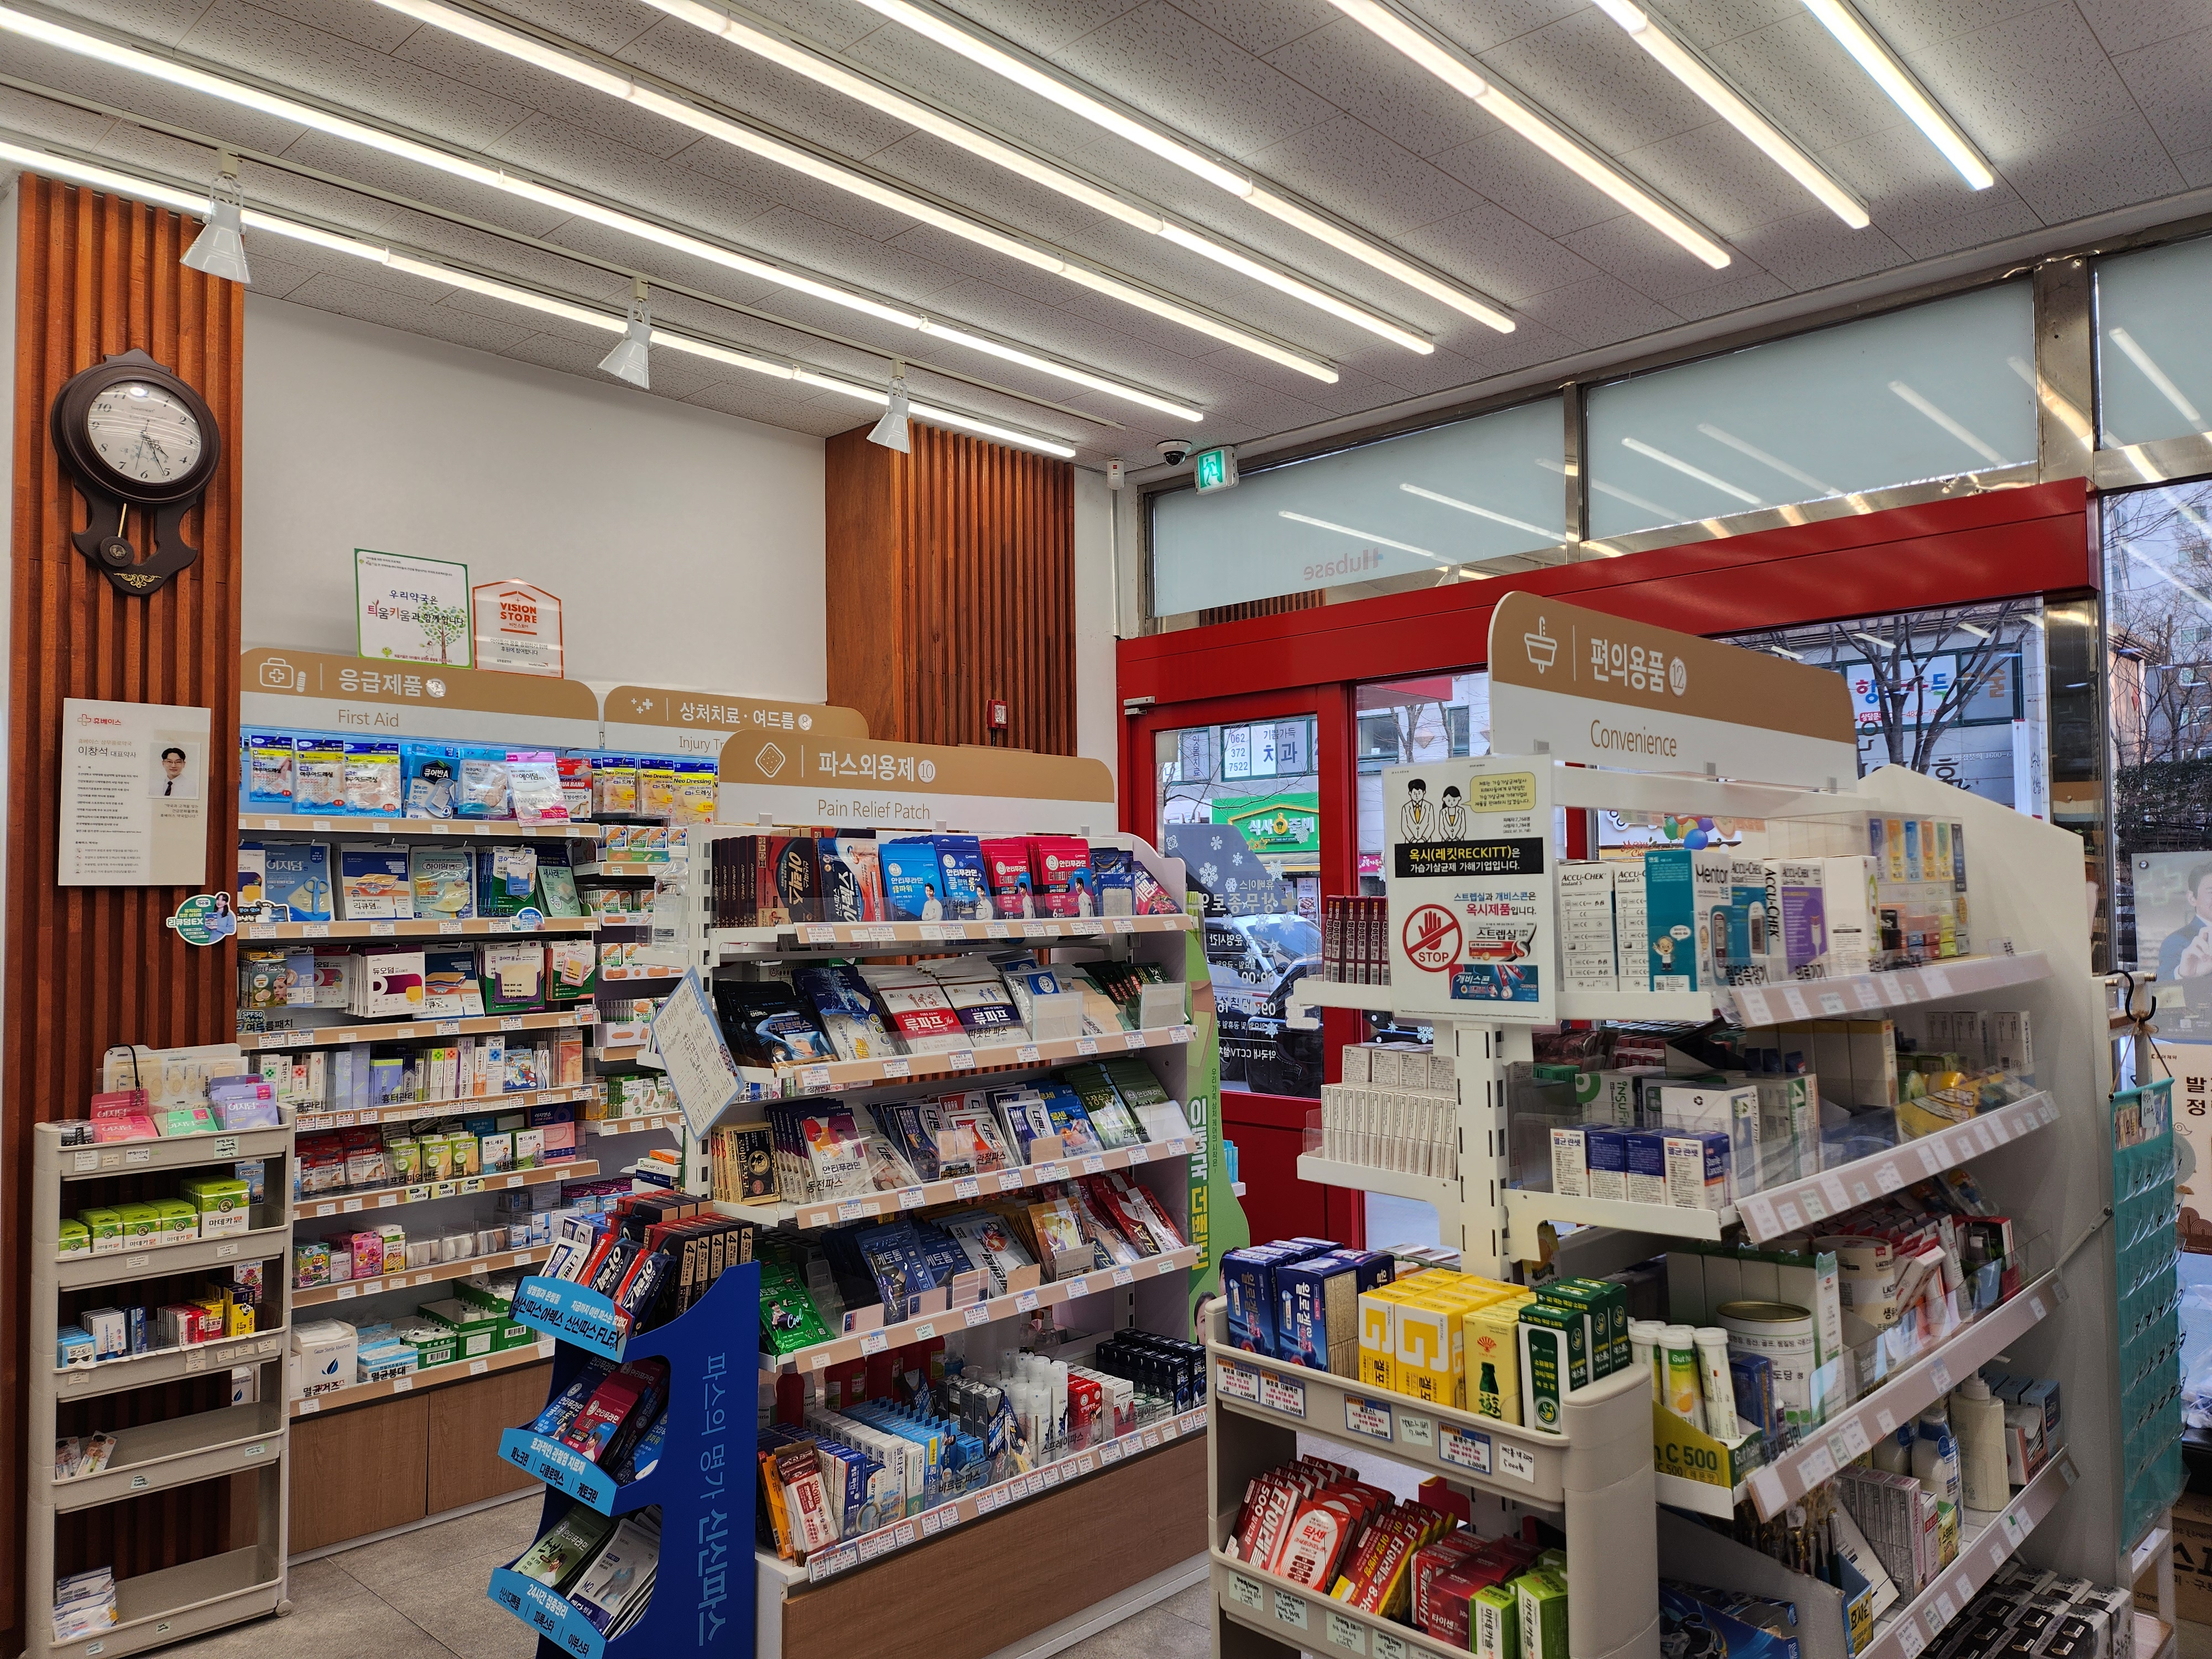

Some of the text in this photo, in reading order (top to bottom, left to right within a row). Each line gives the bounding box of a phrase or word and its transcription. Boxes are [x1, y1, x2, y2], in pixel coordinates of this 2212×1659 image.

[389, 590, 438, 604] 우리약국은
[500, 602, 536, 614] VISION
[424, 613, 440, 623] 함께
[441, 616, 464, 625] 합니다
[500, 612, 537, 623] STORE
[1590, 638, 1684, 693] 편의용품 12
[338, 668, 422, 697] 응급제품
[93, 717, 121, 726] 휴베이스
[338, 709, 399, 727] First Aid
[680, 702, 794, 729] 상처치료 여드름
[1230, 733, 1245, 743] 062
[1264, 727, 1296, 740] 기쁨가득
[1591, 719, 1677, 757] Convenience
[680, 735, 710, 750] Injury
[79, 746, 108, 757] 이창석
[1231, 748, 1245, 757] 372
[424, 768, 448, 778] 큐어반A
[818, 751, 934, 781] 파스외용제 10
[1229, 762, 1248, 772] 7522
[818, 799, 930, 820] Pain Relief Patch
[1248, 817, 1315, 836] 식사 준비
[1409, 845, 1521, 862] 옥시(레킷RECKITT)은
[266, 859, 302, 872] 이지덤
[1410, 859, 1520, 873] 가습기살균제 가해기업입니다.
[788, 852, 804, 905] 아렉스
[946, 869, 978, 877] 안티푸라민
[1562, 873, 1604, 881] ACCU-CHEK
[1454, 891, 1536, 901] 스트렙실과 개비스콘은
[1764, 867, 1780, 937] ACCU-CHEK
[354, 902, 375, 910] 리큐덤
[484, 907, 515, 916] 재생밴드
[943, 900, 983, 911] 시원한 파스
[1466, 903, 1537, 916] 옥시제품입니다.
[1477, 930, 1516, 940] 스트렙실
[1418, 952, 1449, 962] STOP
[1456, 975, 1490, 984] 개비스콘
[904, 1016, 943, 1031] 류파프
[972, 1009, 1010, 1025] 류파프
[247, 1019, 293, 1032] 여드름패치
[969, 1026, 991, 1038] 따뜻한
[382, 1092, 415, 1104] 흉터관리
[1212, 1086, 1217, 1100] 가족
[1212, 1102, 1217, 1117] 상처
[1123, 1126, 1147, 1138] 한방파스
[1553, 1137, 1581, 1147] 멸균 란셋
[977, 1151, 1006, 1164] 관절파스
[495, 1160, 525, 1170] 일반밴드
[390, 1171, 440, 1185] 프리미엄밴드
[807, 1177, 843, 1192] 동전파스
[209, 1217, 232, 1227] 마데카
[877, 1249, 904, 1266] 케토톱
[546, 1291, 561, 1305] 온찜질
[571, 1300, 589, 1315] 지금까지
[589, 1307, 598, 1318] 이런
[598, 1310, 613, 1324] 파스는
[1296, 1281, 1312, 1328] 윌로겔
[787, 1308, 804, 1328] Cool
[372, 1366, 406, 1382] 멸균붕대
[303, 1381, 341, 1398] 멸균거즈
[1041, 1433, 1084, 1454] 스프레이파스
[530, 1437, 587, 1475] 효과적인 관절염 치료제
[1666, 1443, 1718, 1470] C 500
[1666, 1463, 1683, 1477] 500
[539, 1463, 599, 1504] 디클로맥스 케토크린
[940, 1479, 963, 1494] 바르는
[698, 1353, 728, 1646] 파스의 명가 신신파스
[1253, 1484, 1270, 1517] 500
[1249, 1486, 1289, 1568] 타이레놀
[1303, 1525, 1327, 1543] 탁센
[1372, 1535, 1405, 1586] 타이레놀
[581, 1580, 594, 1593] M2
[526, 1583, 569, 1620] 24시간 집중관리
[1432, 1614, 1454, 1630] 타이센
[567, 1633, 590, 1658] 이부스타
